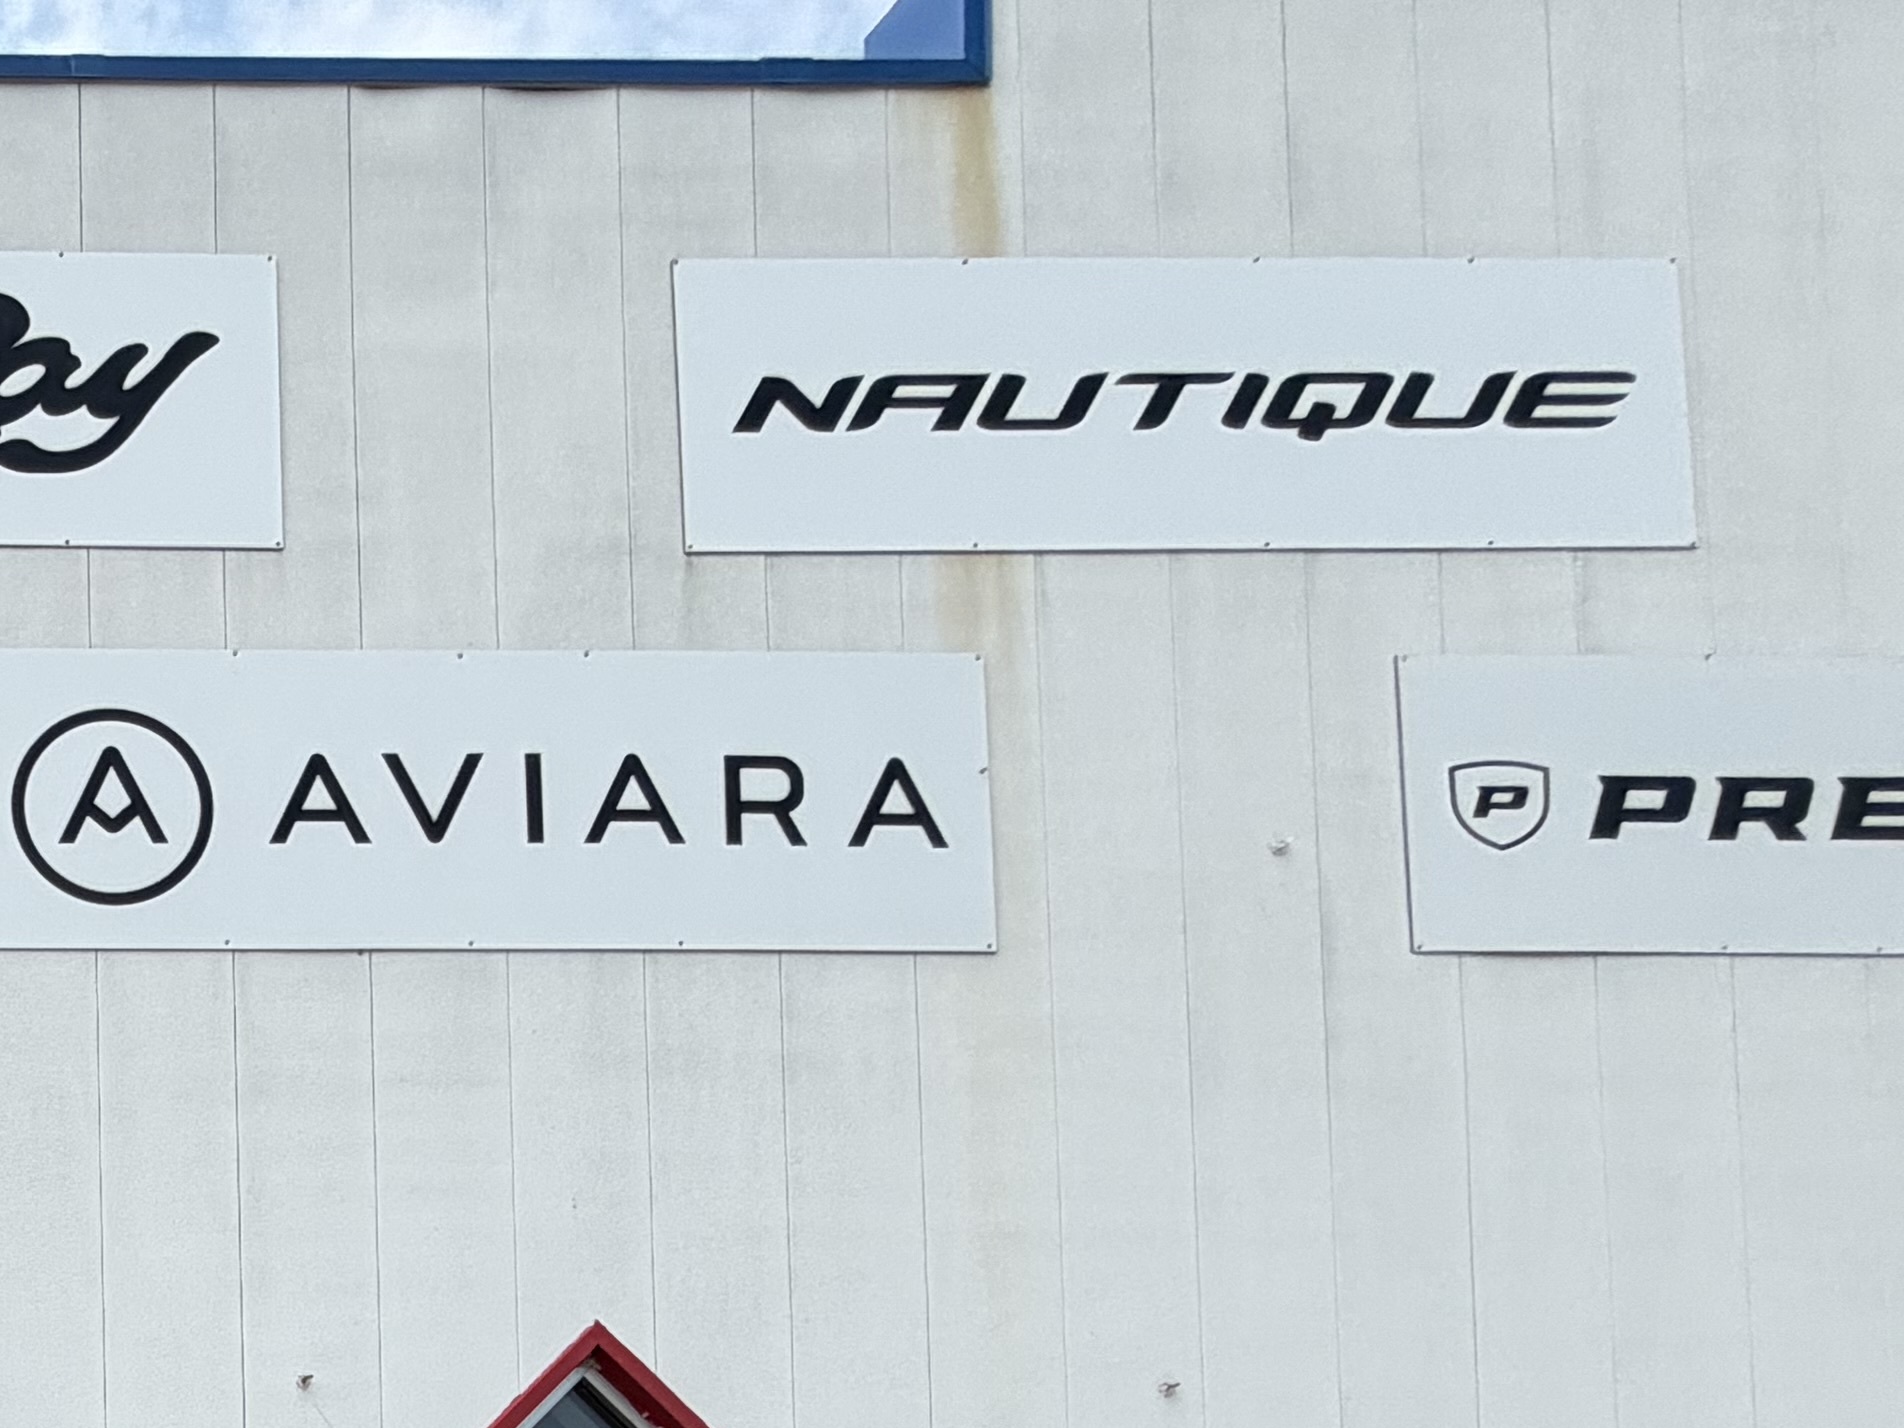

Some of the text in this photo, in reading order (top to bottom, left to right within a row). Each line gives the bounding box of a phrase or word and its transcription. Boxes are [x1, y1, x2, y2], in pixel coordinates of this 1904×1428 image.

[732, 370, 1638, 441] NAUTIQUE
[269, 751, 950, 848] AVIARA
[1473, 786, 1529, 818] P
